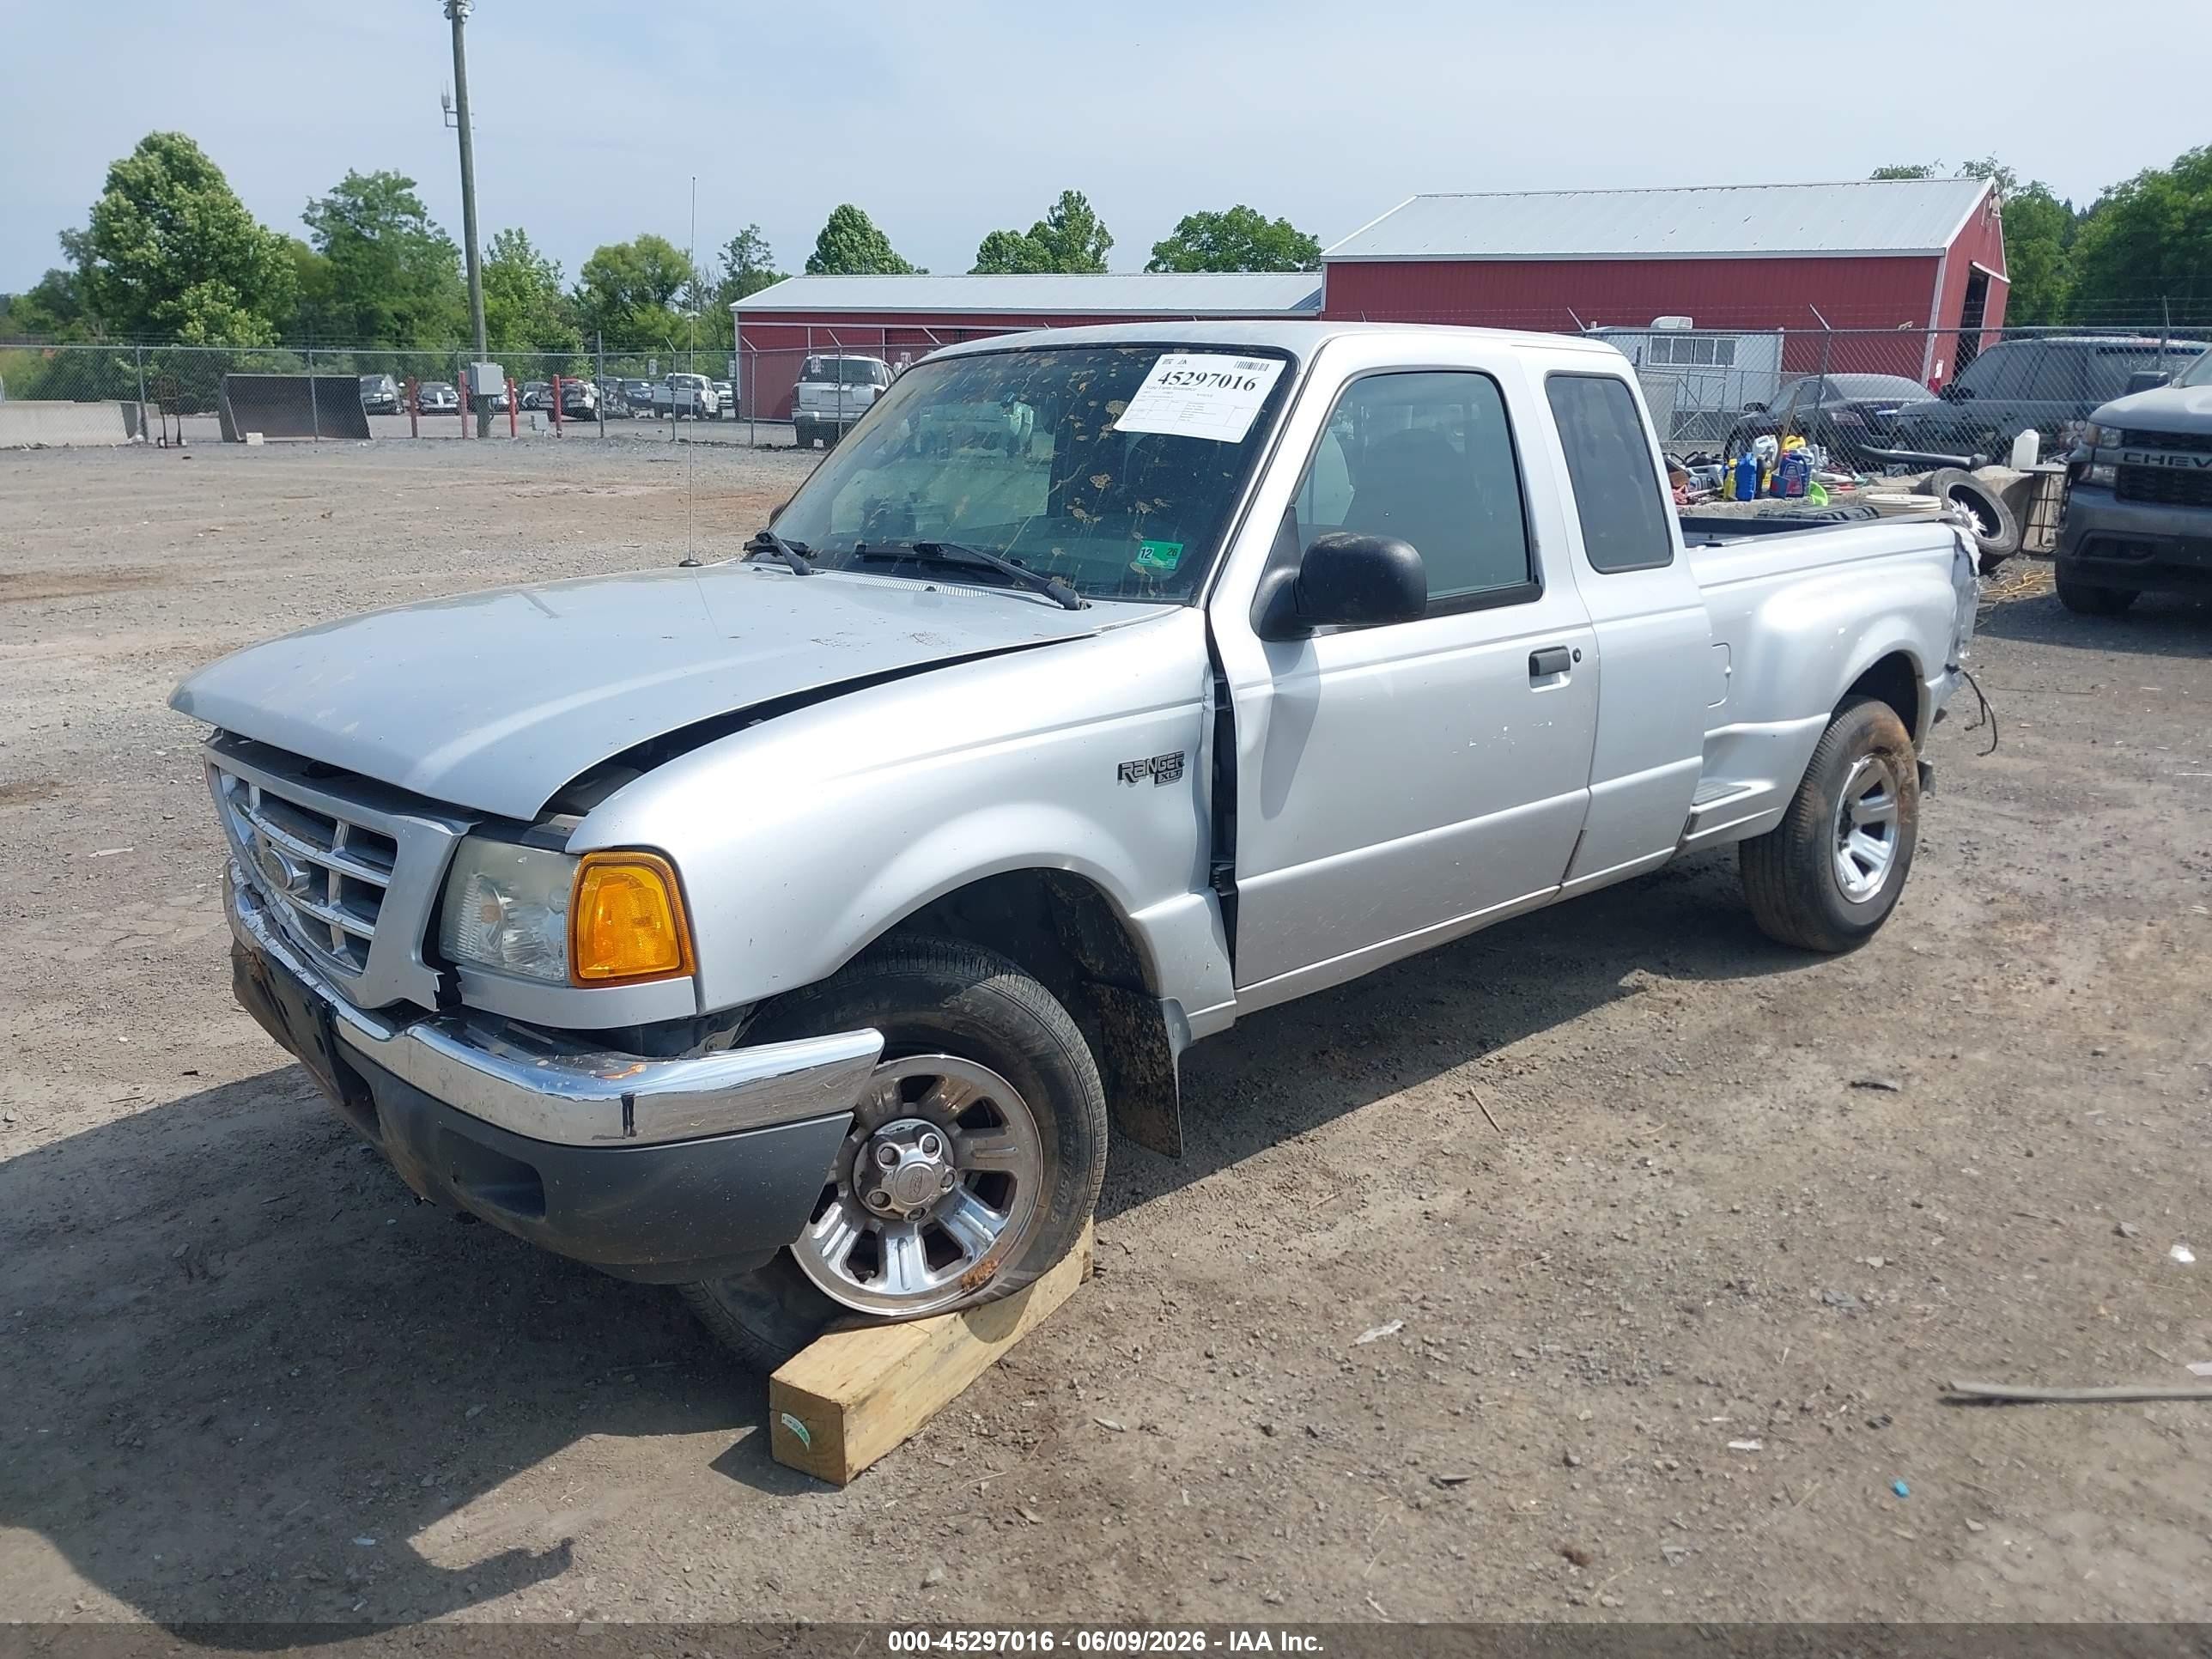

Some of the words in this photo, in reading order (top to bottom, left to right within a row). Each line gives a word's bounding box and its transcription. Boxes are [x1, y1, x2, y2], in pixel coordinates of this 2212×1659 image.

[1158, 370, 1261, 392] 45297016
[1140, 548, 1153, 559] 12
[1117, 750, 1185, 784] RANGER
[1157, 769, 1182, 783] XLT
